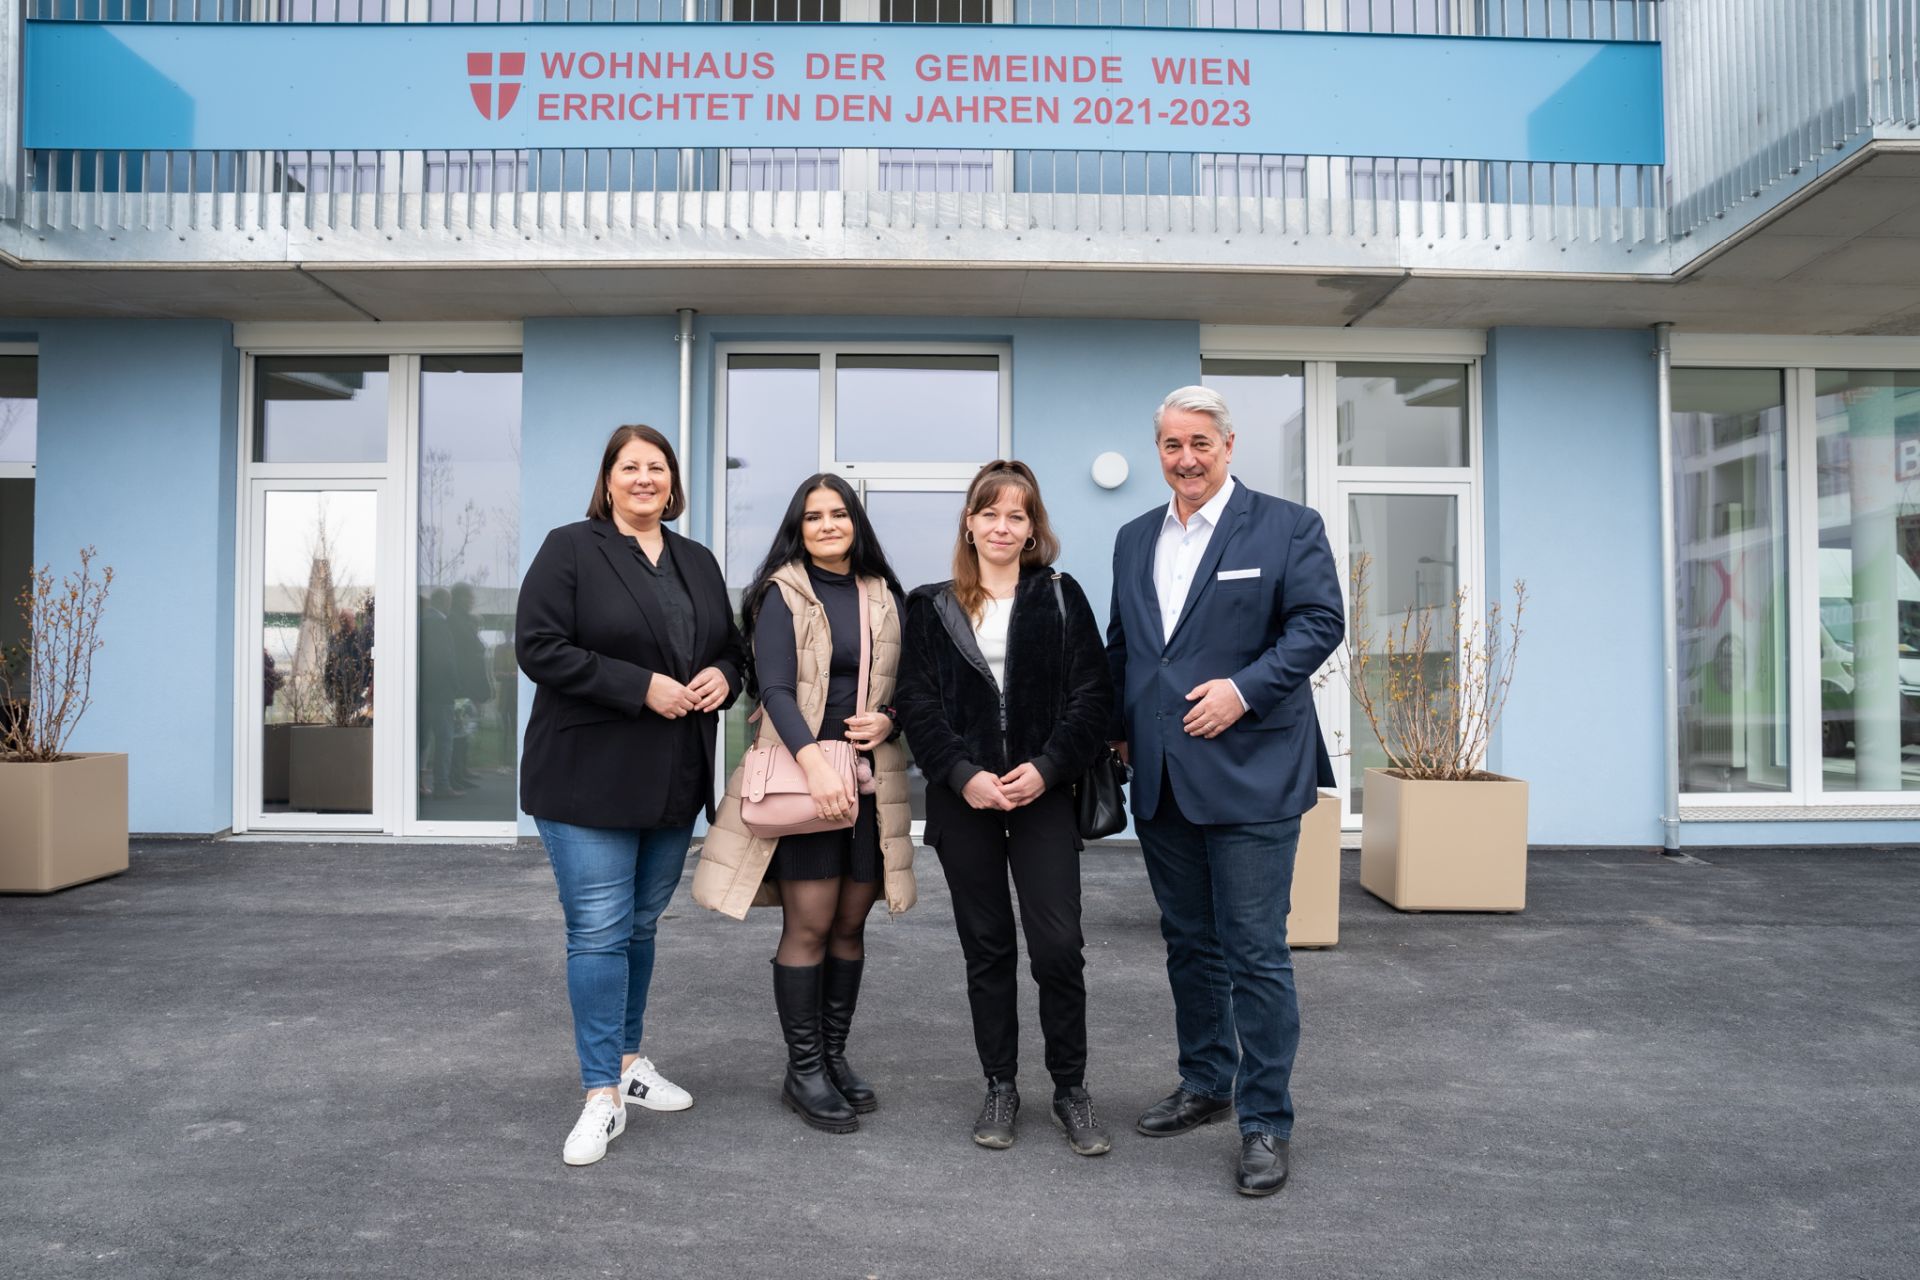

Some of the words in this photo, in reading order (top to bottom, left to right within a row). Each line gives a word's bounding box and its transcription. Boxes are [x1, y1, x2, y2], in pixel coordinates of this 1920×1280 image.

[540, 51, 776, 81] WOHNHAUS
[805, 52, 885, 81] DER
[914, 53, 1123, 84] GEMEINDE
[1151, 56, 1251, 86] WIEN
[537, 92, 754, 122] ERRICHTET
[766, 93, 801, 122] IN
[815, 93, 893, 123] DEN
[904, 95, 1060, 125] JAHREN
[1072, 96, 1252, 128] 2021-2023
